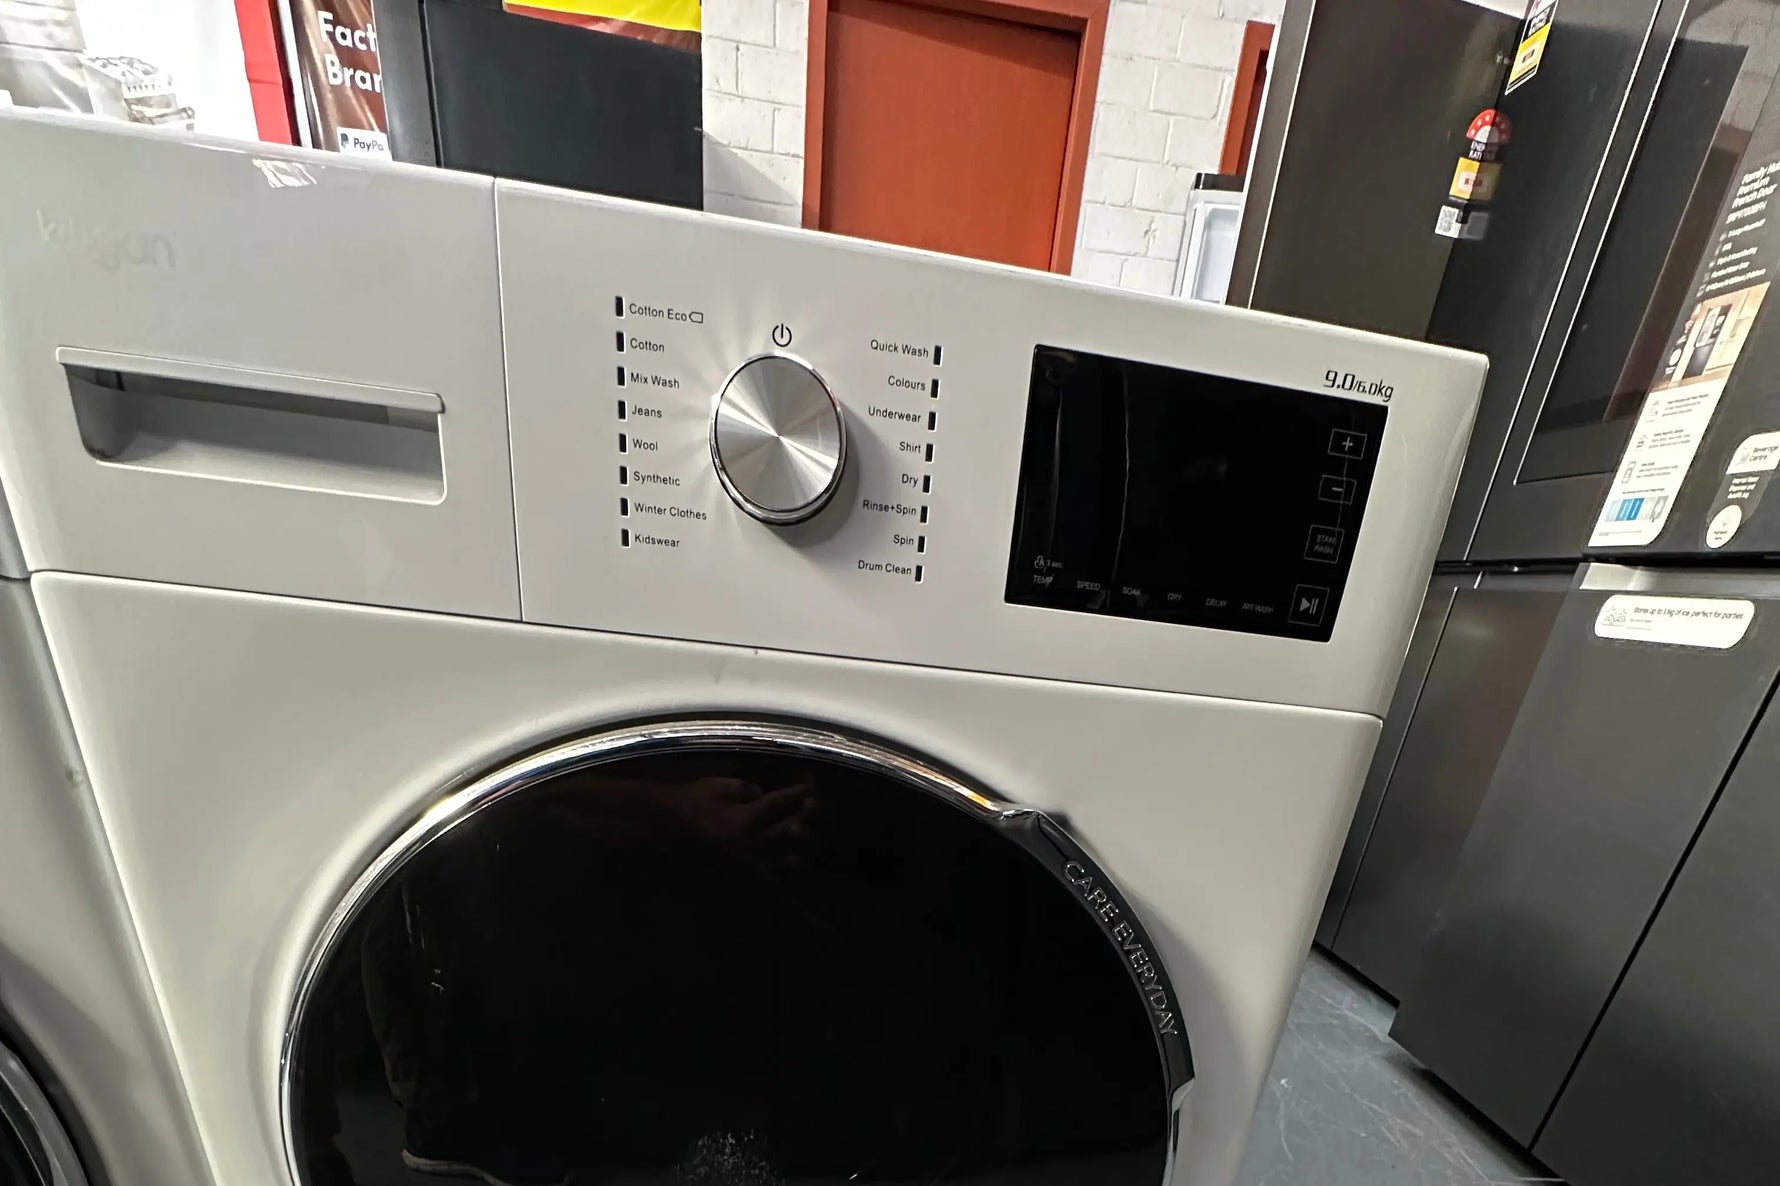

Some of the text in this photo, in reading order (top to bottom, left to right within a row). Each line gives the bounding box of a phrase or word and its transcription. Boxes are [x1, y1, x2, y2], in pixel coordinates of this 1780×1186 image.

[629, 304, 688, 322] Cotton Eco
[630, 338, 665, 352] Cotton
[870, 340, 928, 358] Quick Wash
[630, 373, 680, 388] Mix Wash
[888, 376, 926, 391] Colours
[1323, 370, 1394, 402] 9.0/6.0kg
[632, 406, 662, 418] Jeans
[868, 406, 921, 424] Underwear
[632, 439, 658, 452] Wool
[900, 442, 921, 453] Shirt
[634, 472, 680, 486] Synthetic
[902, 474, 918, 487] Dry
[634, 503, 707, 520] Winter Clothes
[862, 500, 916, 516] Rinse+Spin
[634, 534, 680, 548] Kidswear
[894, 534, 914, 548] Spin
[858, 560, 912, 576] Drum Clean
[1033, 574, 1054, 584] TEMP
[1076, 580, 1101, 591] SPEED
[1065, 860, 1178, 1035] CARE EVERYDAY
